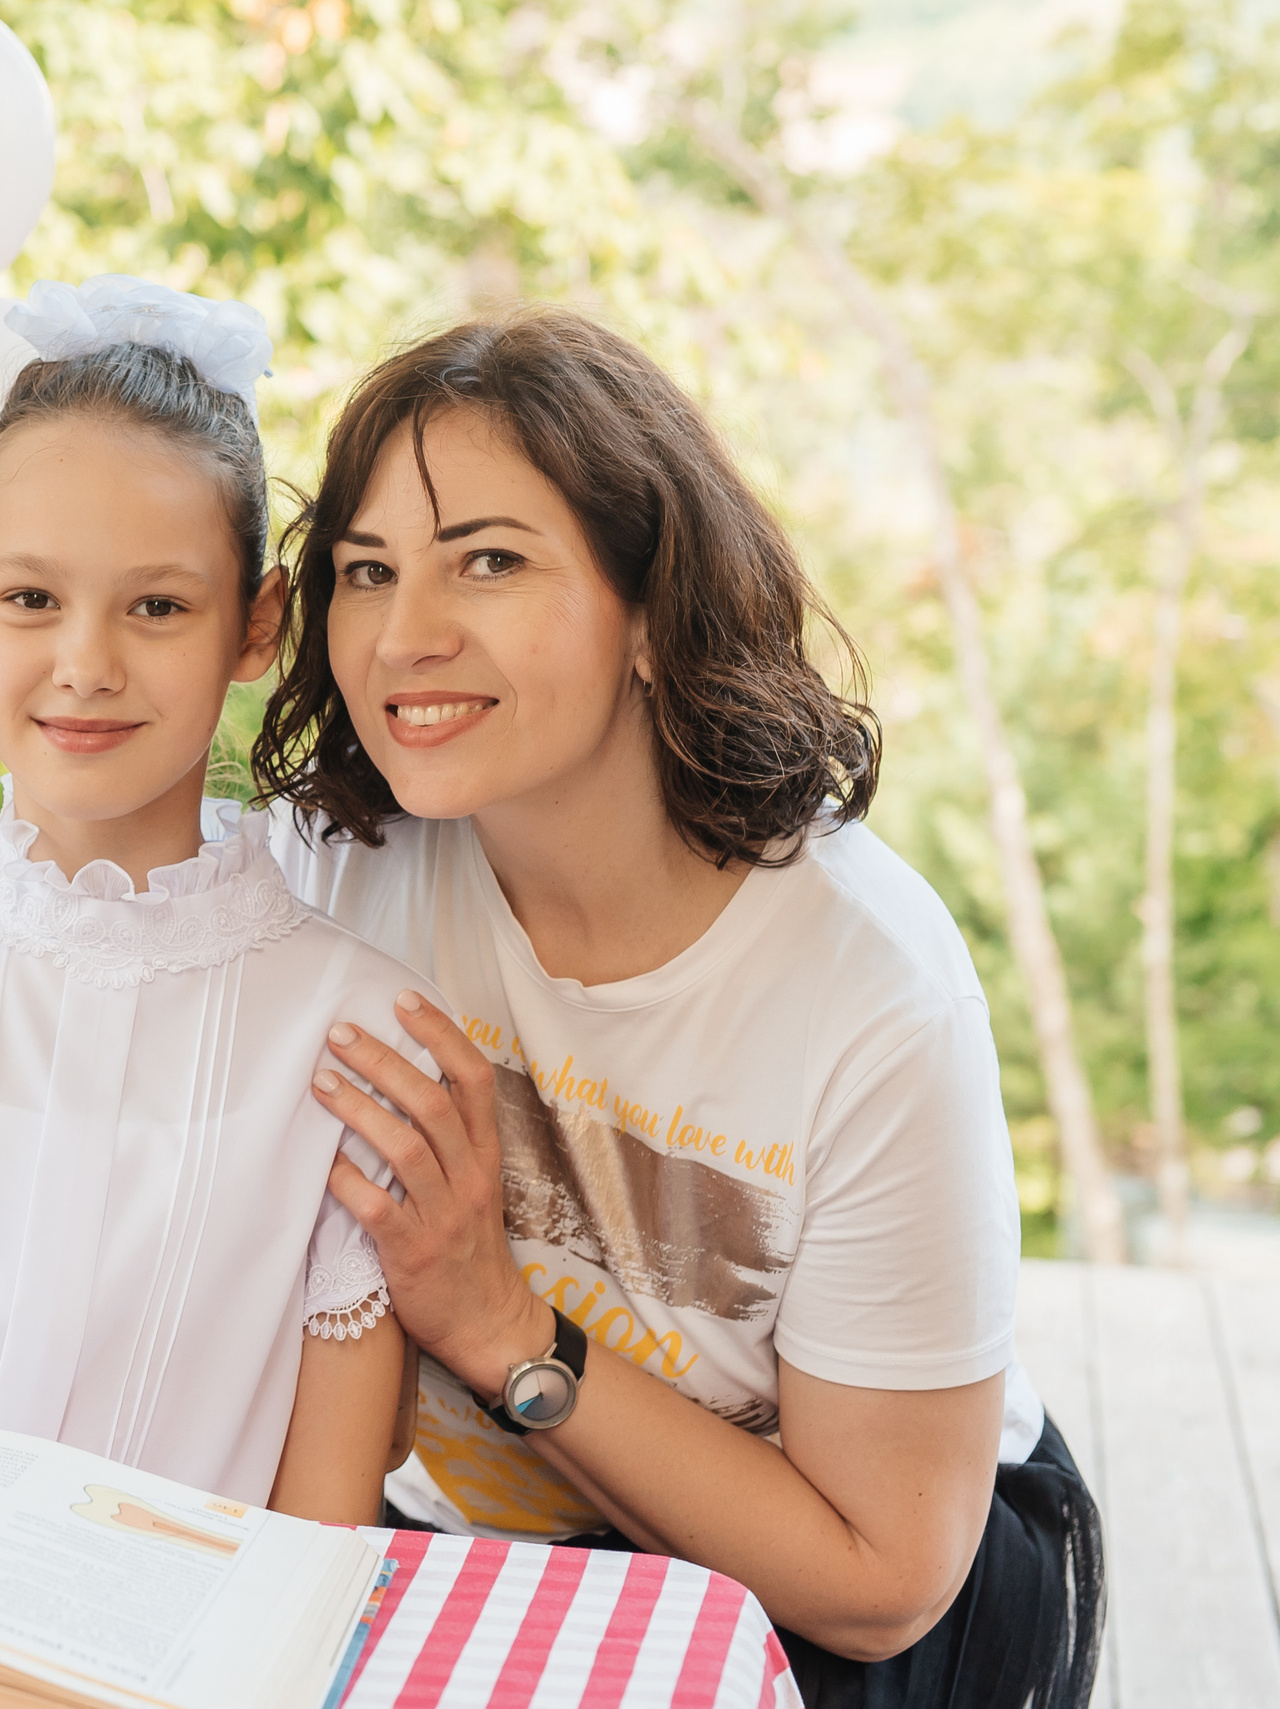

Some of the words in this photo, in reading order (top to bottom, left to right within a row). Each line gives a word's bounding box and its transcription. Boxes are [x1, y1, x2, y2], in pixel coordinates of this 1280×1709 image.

[531, 1053, 610, 1110] what
[612, 1093, 660, 1139] you
[666, 1104, 728, 1157] love
[733, 1138, 795, 1187] with
